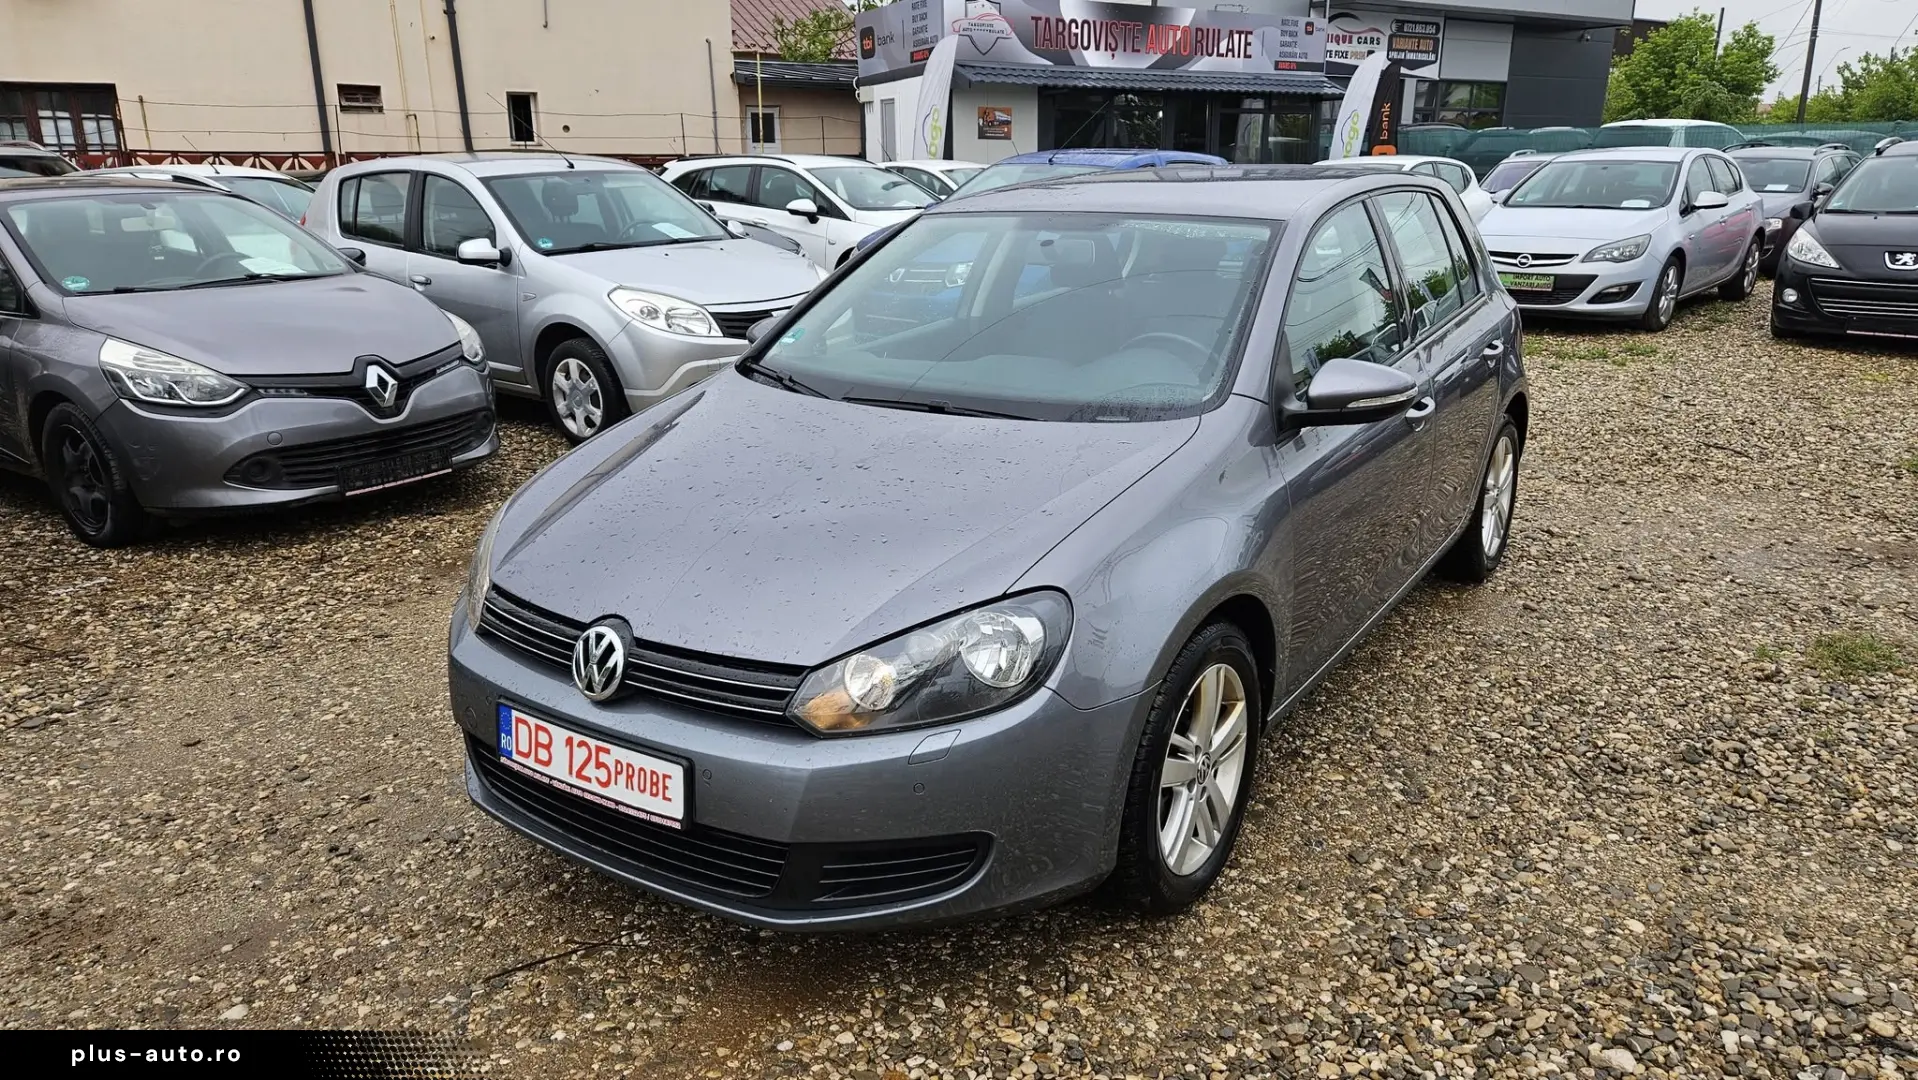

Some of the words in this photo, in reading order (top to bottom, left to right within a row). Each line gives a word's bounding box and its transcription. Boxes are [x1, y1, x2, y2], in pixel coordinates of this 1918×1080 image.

[863, 35, 872, 50] tbi
[877, 31, 895, 46] bank
[1031, 16, 1142, 60] TARGOVIȘTE
[1145, 24, 1192, 56] AUTO
[1194, 28, 1253, 59] RULATE
[1357, 36, 1380, 46] CARS
[1419, 39, 1434, 50] AUTO
[1334, 50, 1348, 59] FIXE
[1380, 102, 1391, 140] bank
[501, 732, 512, 751] RO
[514, 716, 553, 768] DB
[564, 736, 612, 789] 125
[614, 758, 672, 802] PROBE
